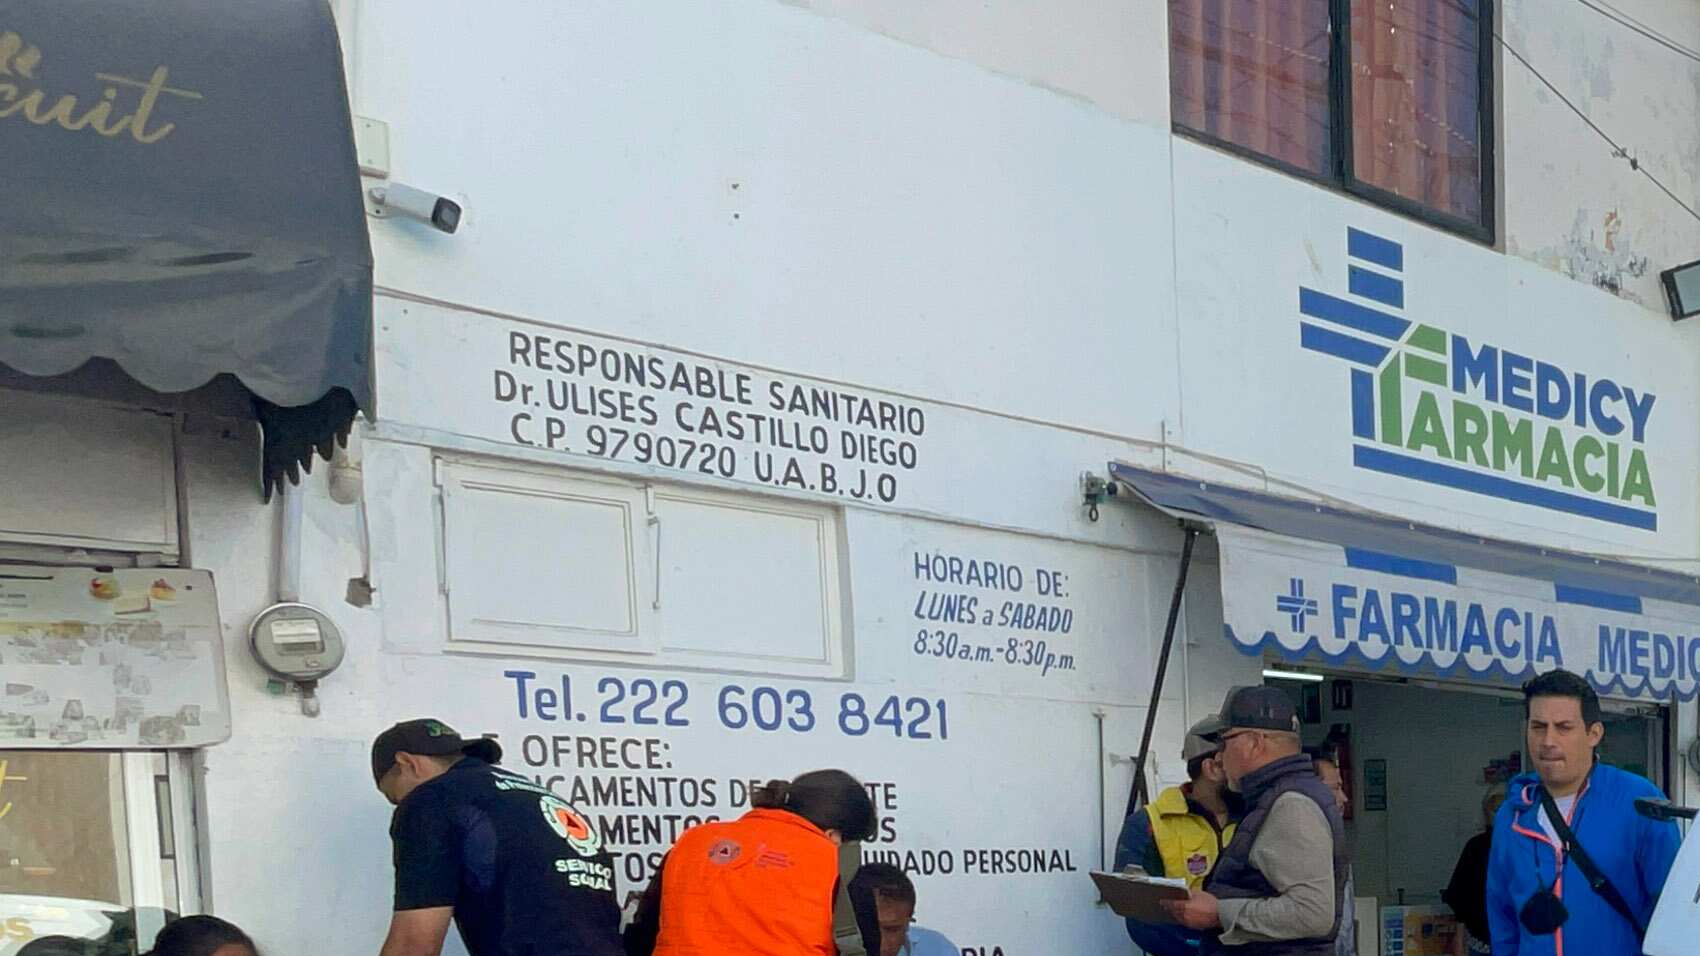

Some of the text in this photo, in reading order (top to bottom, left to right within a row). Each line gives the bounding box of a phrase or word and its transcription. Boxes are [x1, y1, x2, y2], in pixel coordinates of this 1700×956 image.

[510, 331, 925, 436] RESPONSABLE SANITARIO
[1451, 333, 1657, 443] MEDICY
[511, 412, 571, 452] C.P.
[587, 425, 736, 478] 9790720
[676, 402, 829, 454] CASTILLO
[841, 431, 917, 469] DIEGO
[914, 552, 1069, 597] HORARIO DE:
[914, 590, 1073, 633] LUNES a SABADO
[1332, 583, 1564, 666] FARMACIA
[504, 670, 949, 740] Tel. 222 603 8421
[522, 735, 673, 769] OFRECE:
[964, 850, 1077, 873] PERSONAL
